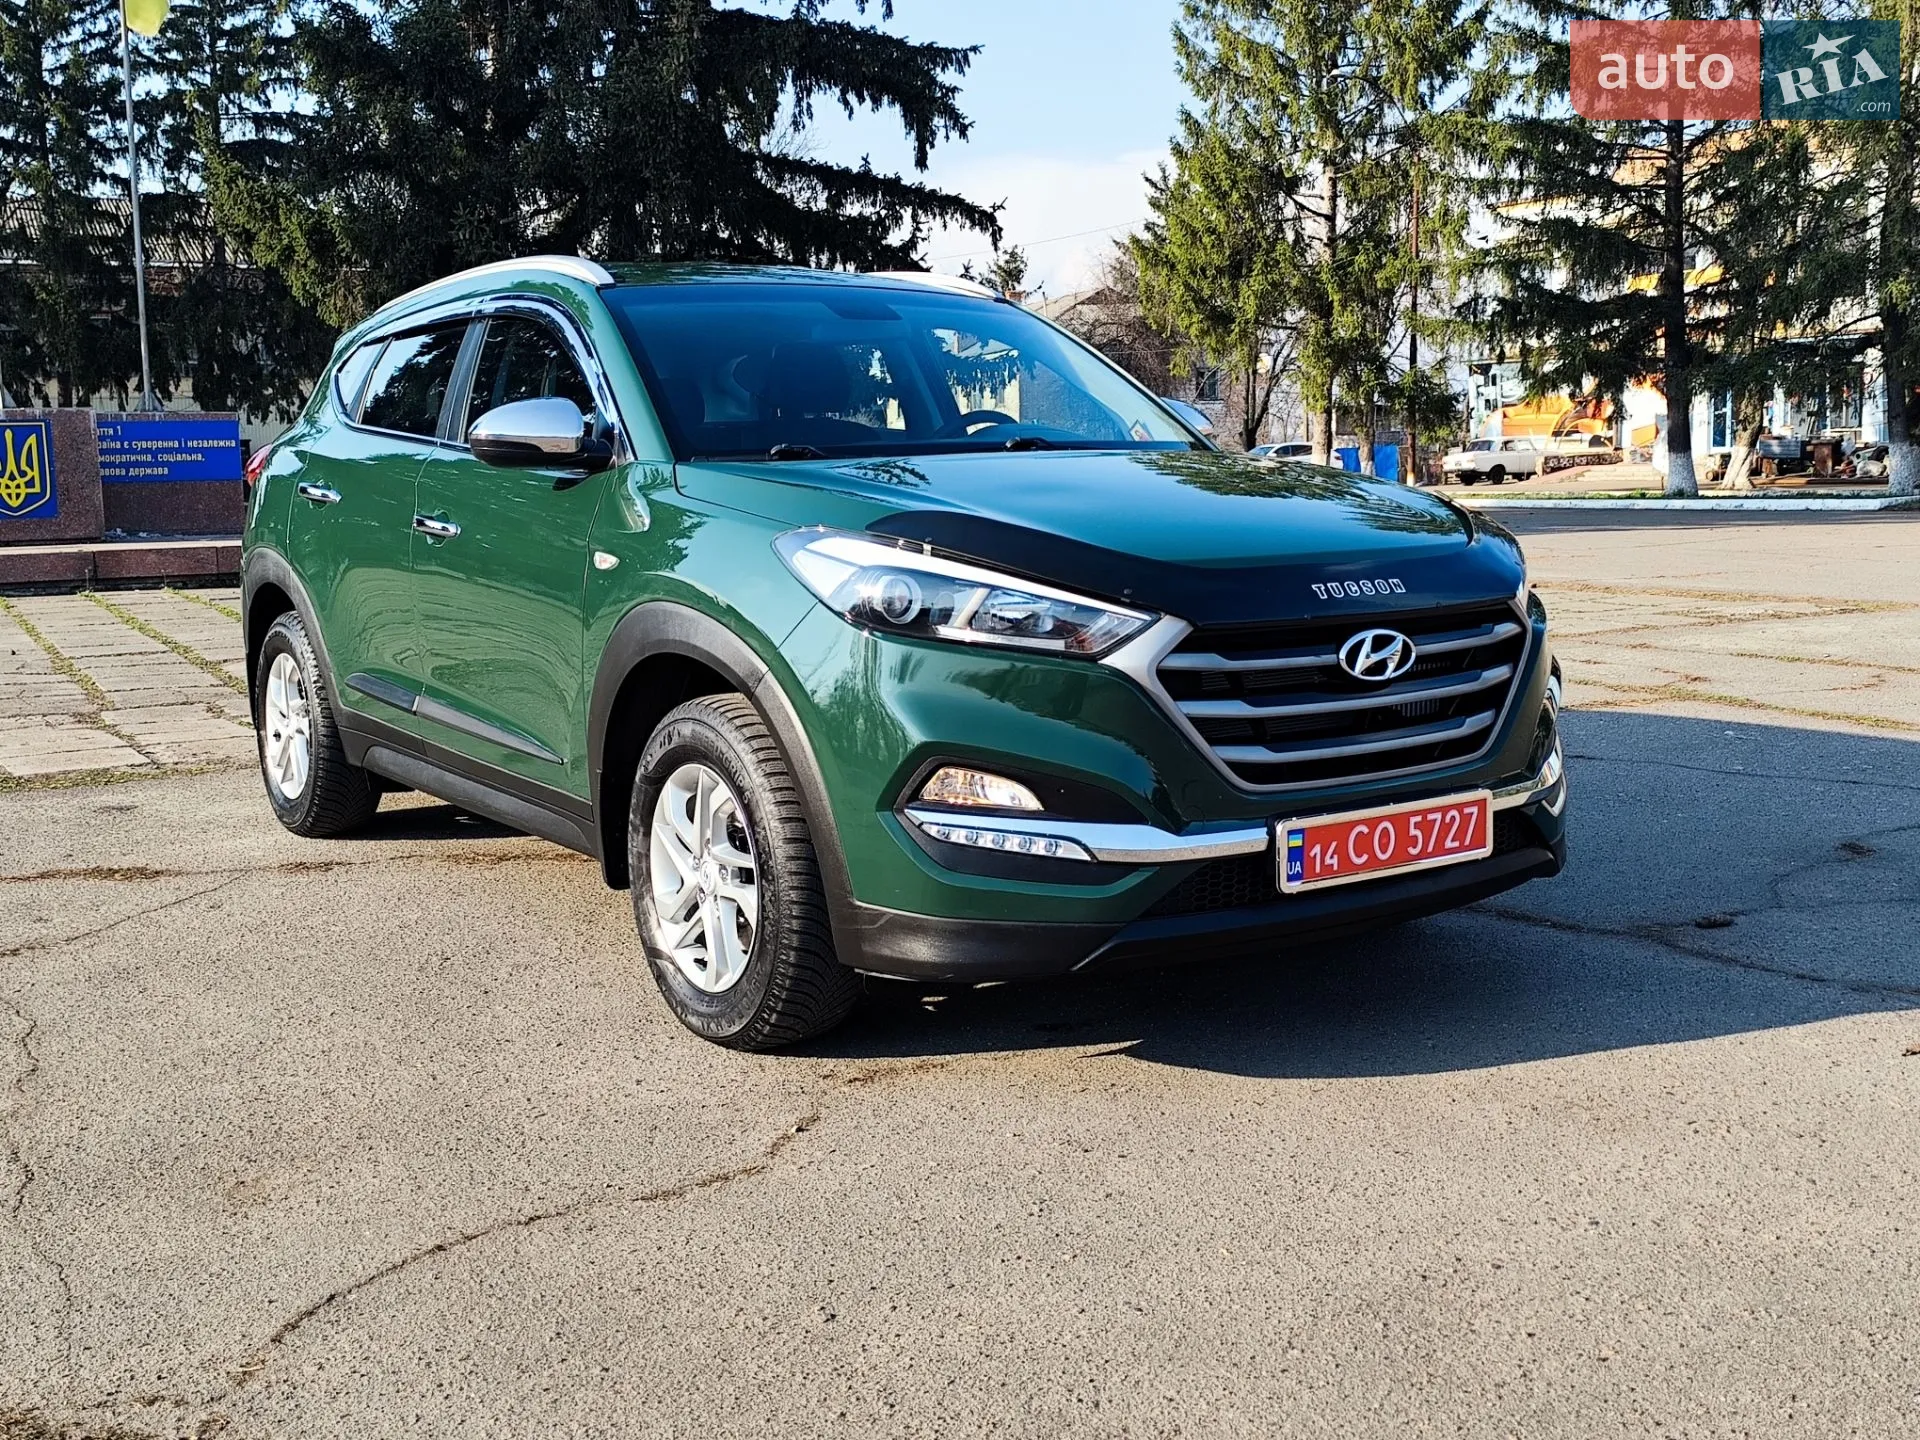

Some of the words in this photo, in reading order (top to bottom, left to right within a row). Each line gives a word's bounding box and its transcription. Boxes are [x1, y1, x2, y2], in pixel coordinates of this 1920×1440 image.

[116, 425, 122, 435] 1
[132, 440, 179, 451] суверенна
[181, 438, 185, 447] і
[187, 439, 236, 448] незалежна
[157, 452, 205, 462] соціальна,
[128, 467, 169, 477] держава
[1311, 579, 1406, 599] TUCSON
[1309, 841, 1339, 874] 14
[1348, 820, 1396, 865] CO
[1407, 805, 1479, 856] 5727
[1287, 861, 1302, 875] UA
